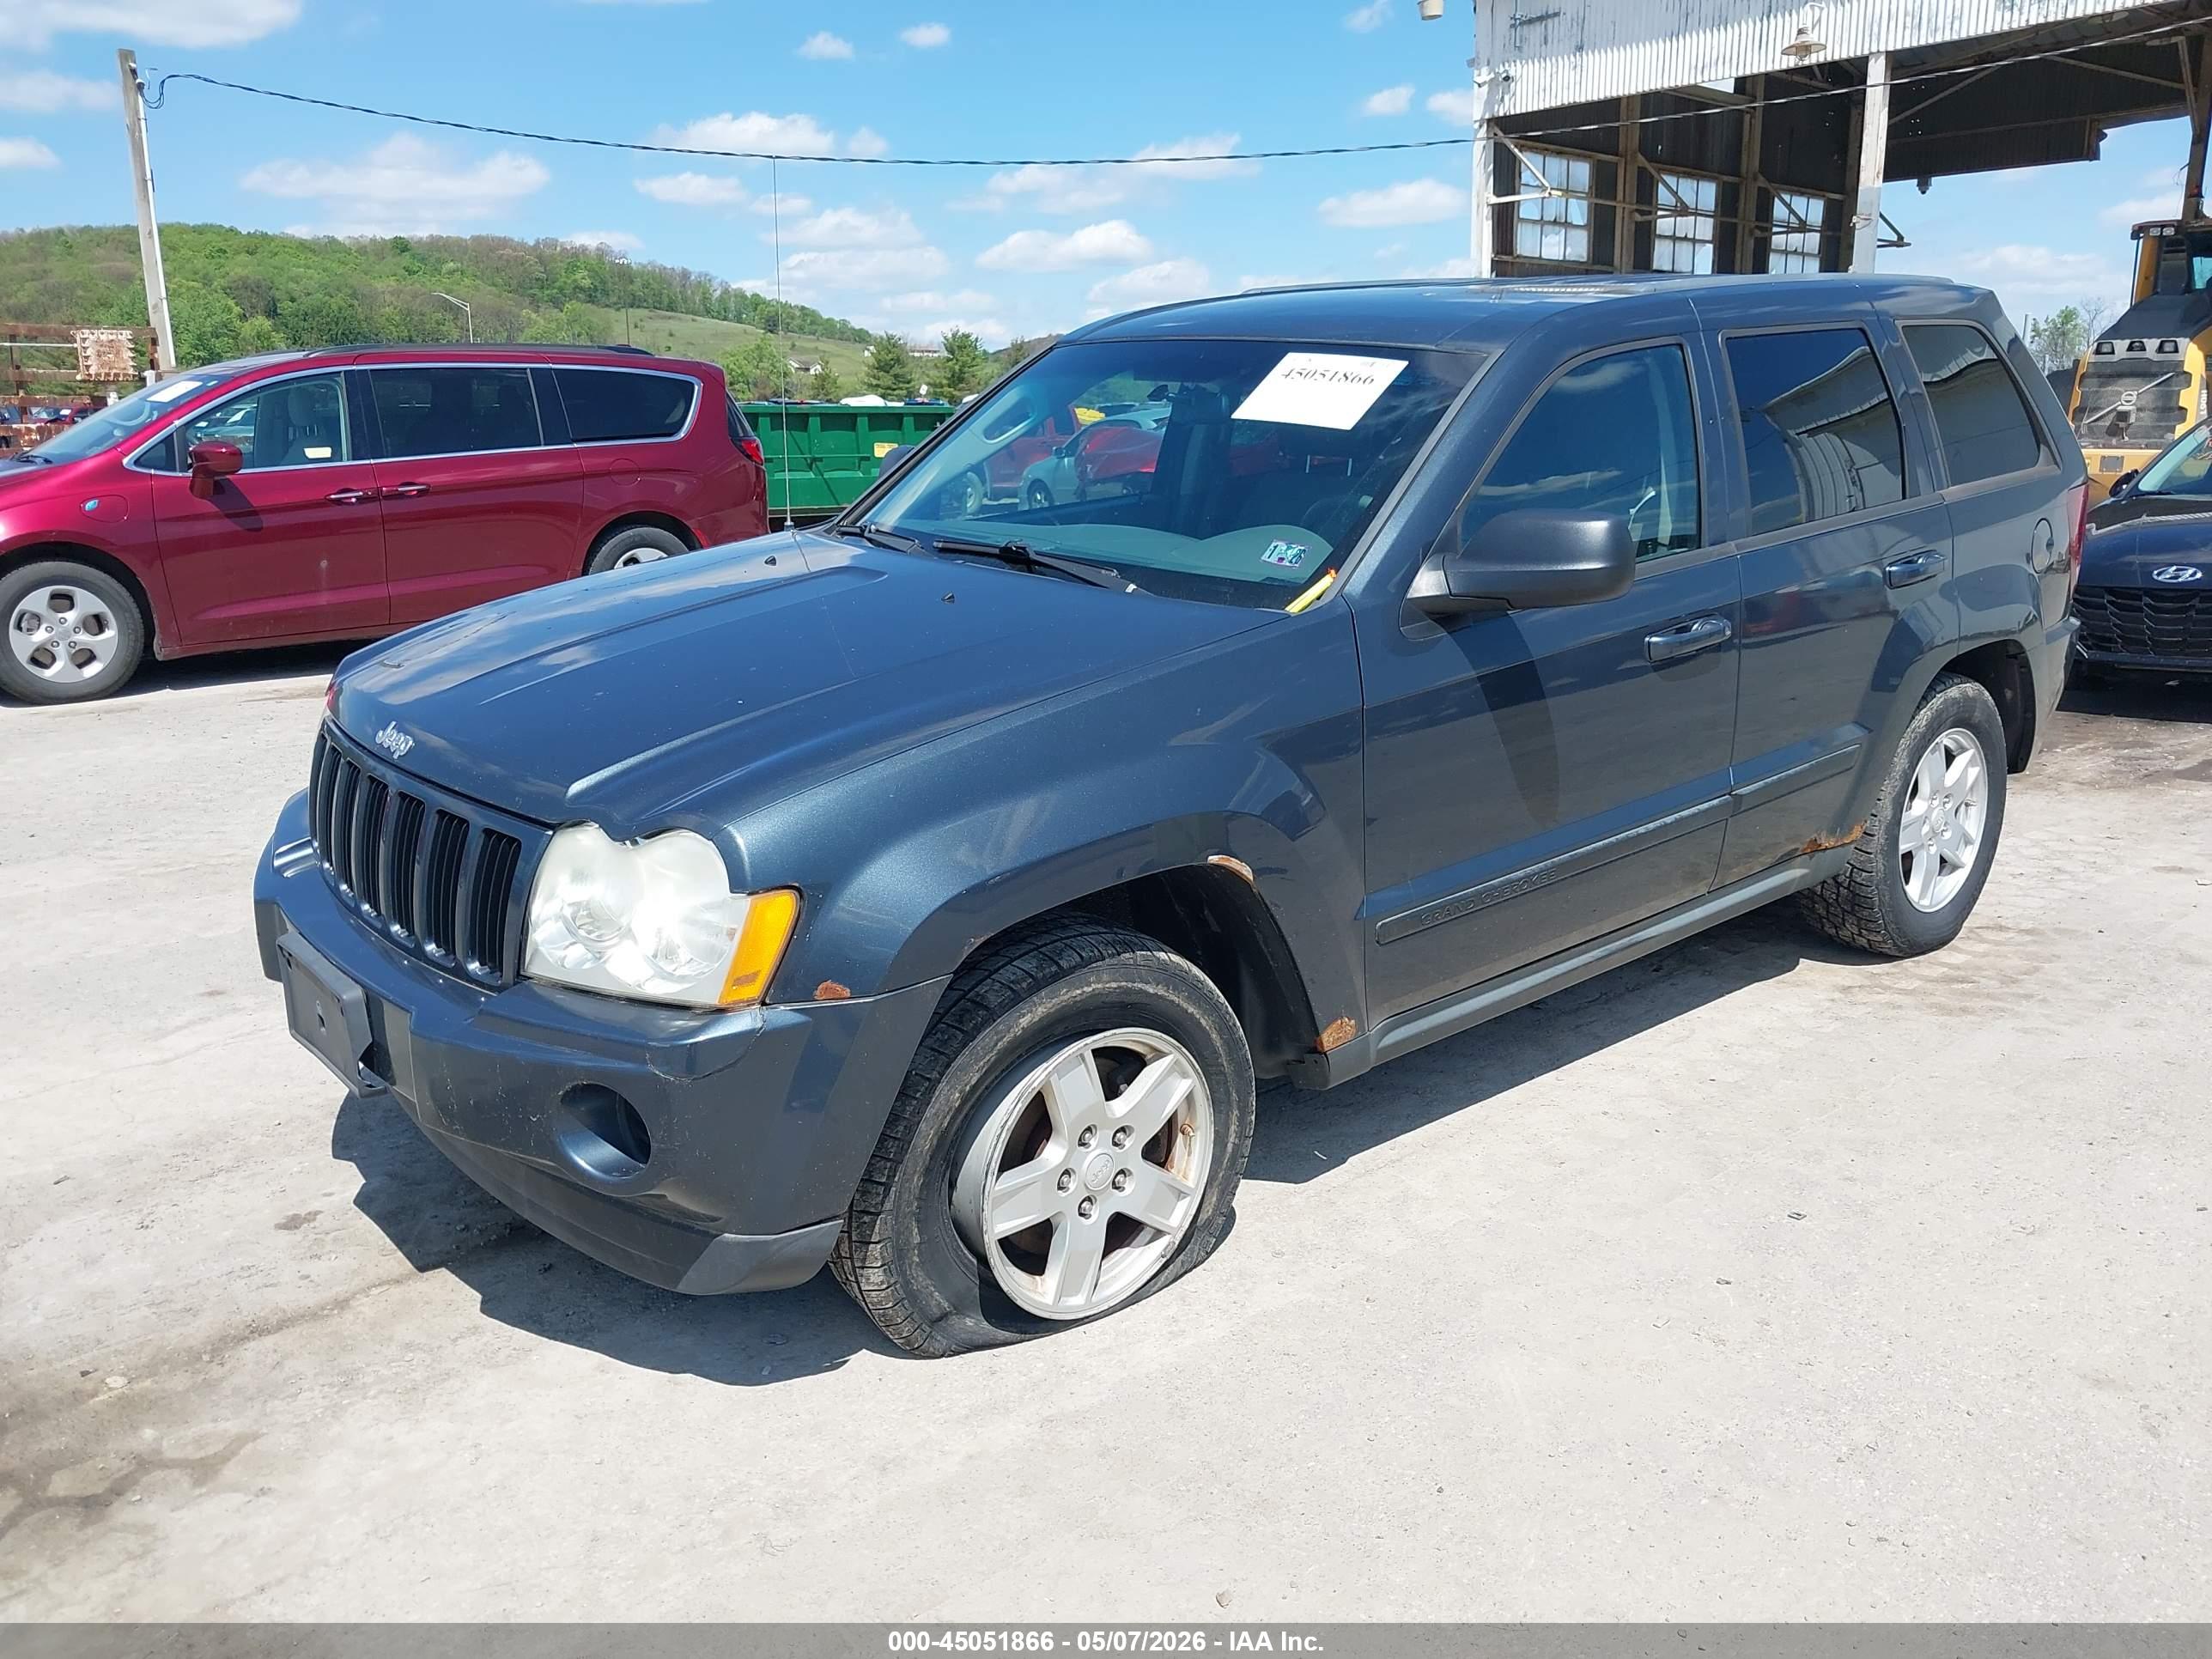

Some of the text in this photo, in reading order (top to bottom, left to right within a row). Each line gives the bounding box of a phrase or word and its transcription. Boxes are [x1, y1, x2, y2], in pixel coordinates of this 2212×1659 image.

[1281, 368, 1375, 385] 45051866
[375, 720, 414, 760] Jeep
[1421, 867, 1557, 926] GRAND CHEROKEE
